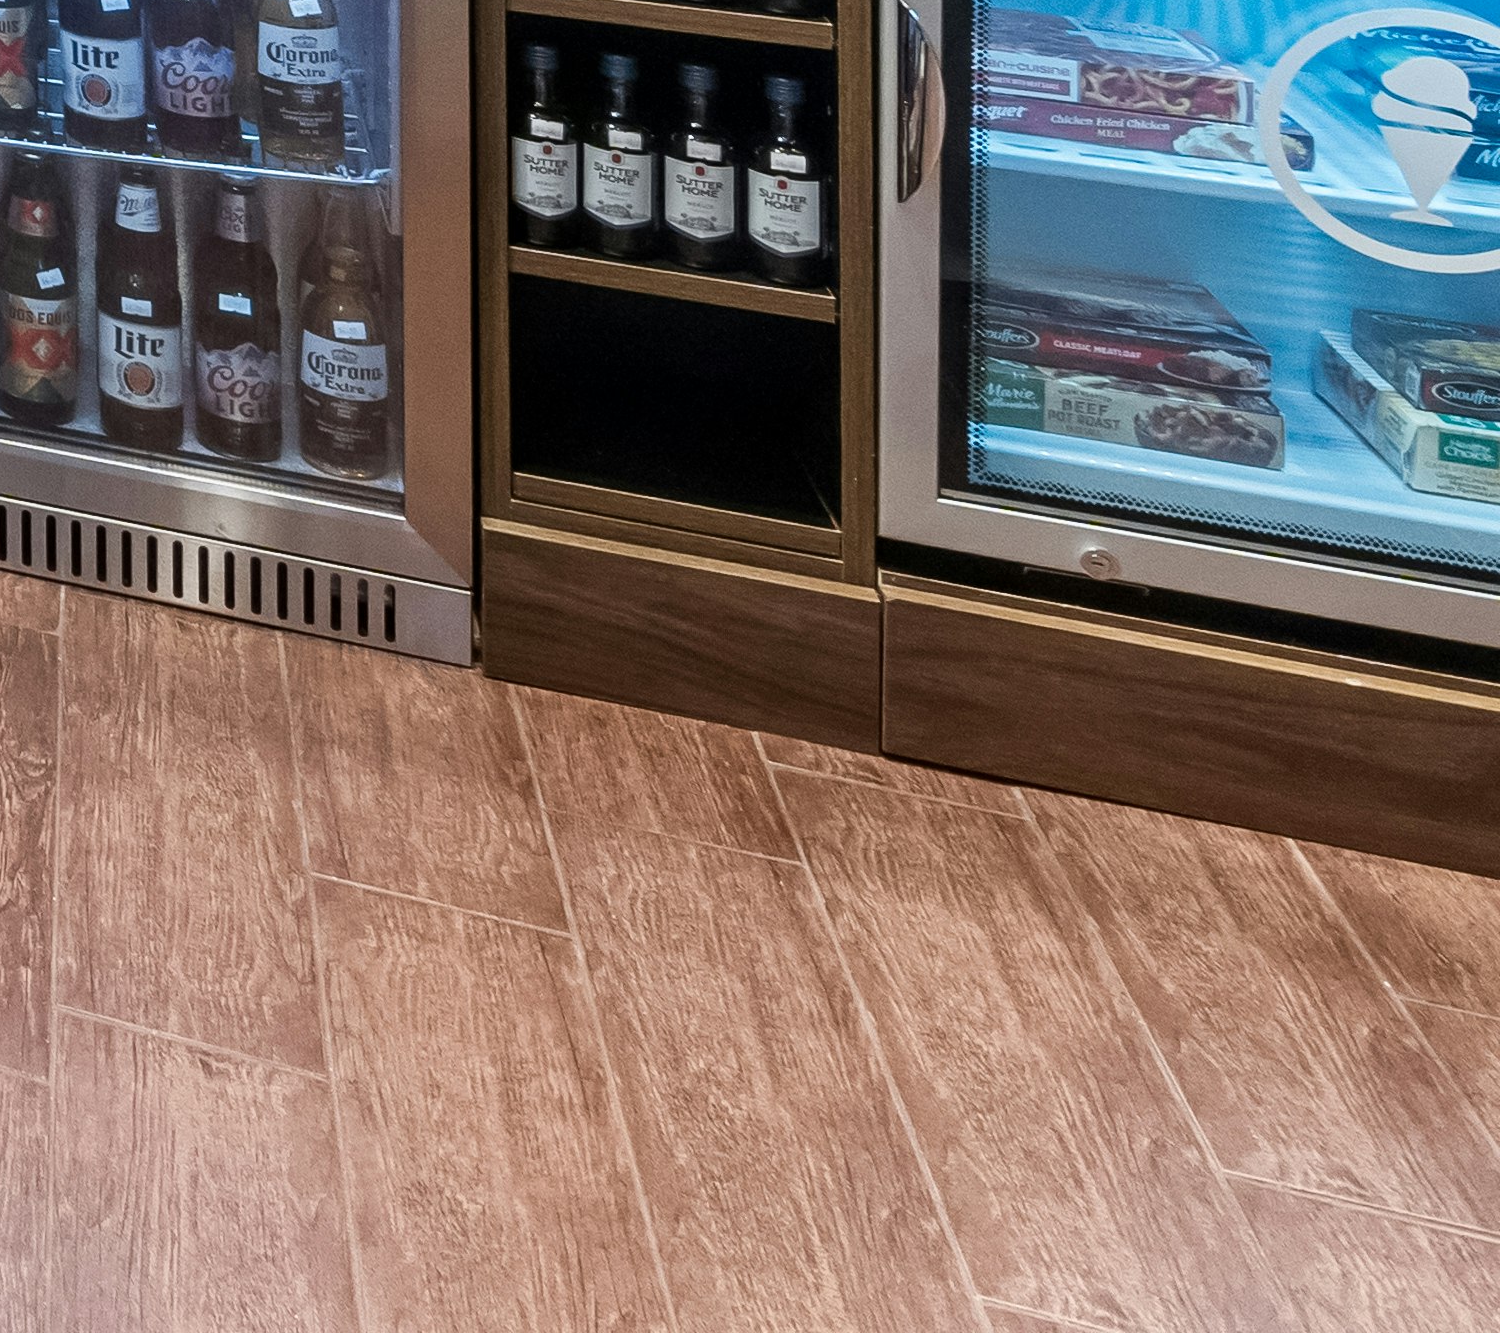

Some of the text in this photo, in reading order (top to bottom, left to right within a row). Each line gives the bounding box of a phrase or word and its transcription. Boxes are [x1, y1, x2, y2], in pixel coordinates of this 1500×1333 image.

[71, 39, 120, 70] Lite
[266, 42, 339, 66] Corona
[286, 64, 327, 79] Extra
[1050, 114, 1170, 131] Chicken Chicken
[523, 153, 569, 169] SUTTER
[594, 161, 640, 177] SUTTER
[530, 164, 565, 175] HOME
[600, 173, 635, 186] HOME
[675, 173, 724, 189] SUTTER
[682, 185, 718, 198] HOME
[759, 186, 807, 204] SUTTER
[765, 199, 801, 212] HOME
[114, 329, 166, 358] Lite
[1052, 339, 1092, 353] CLASSIC
[308, 352, 384, 381] Corona
[324, 377, 366, 395] Extra
[1061, 398, 1110, 415] BEEF
[1078, 413, 1122, 431] ROAST
